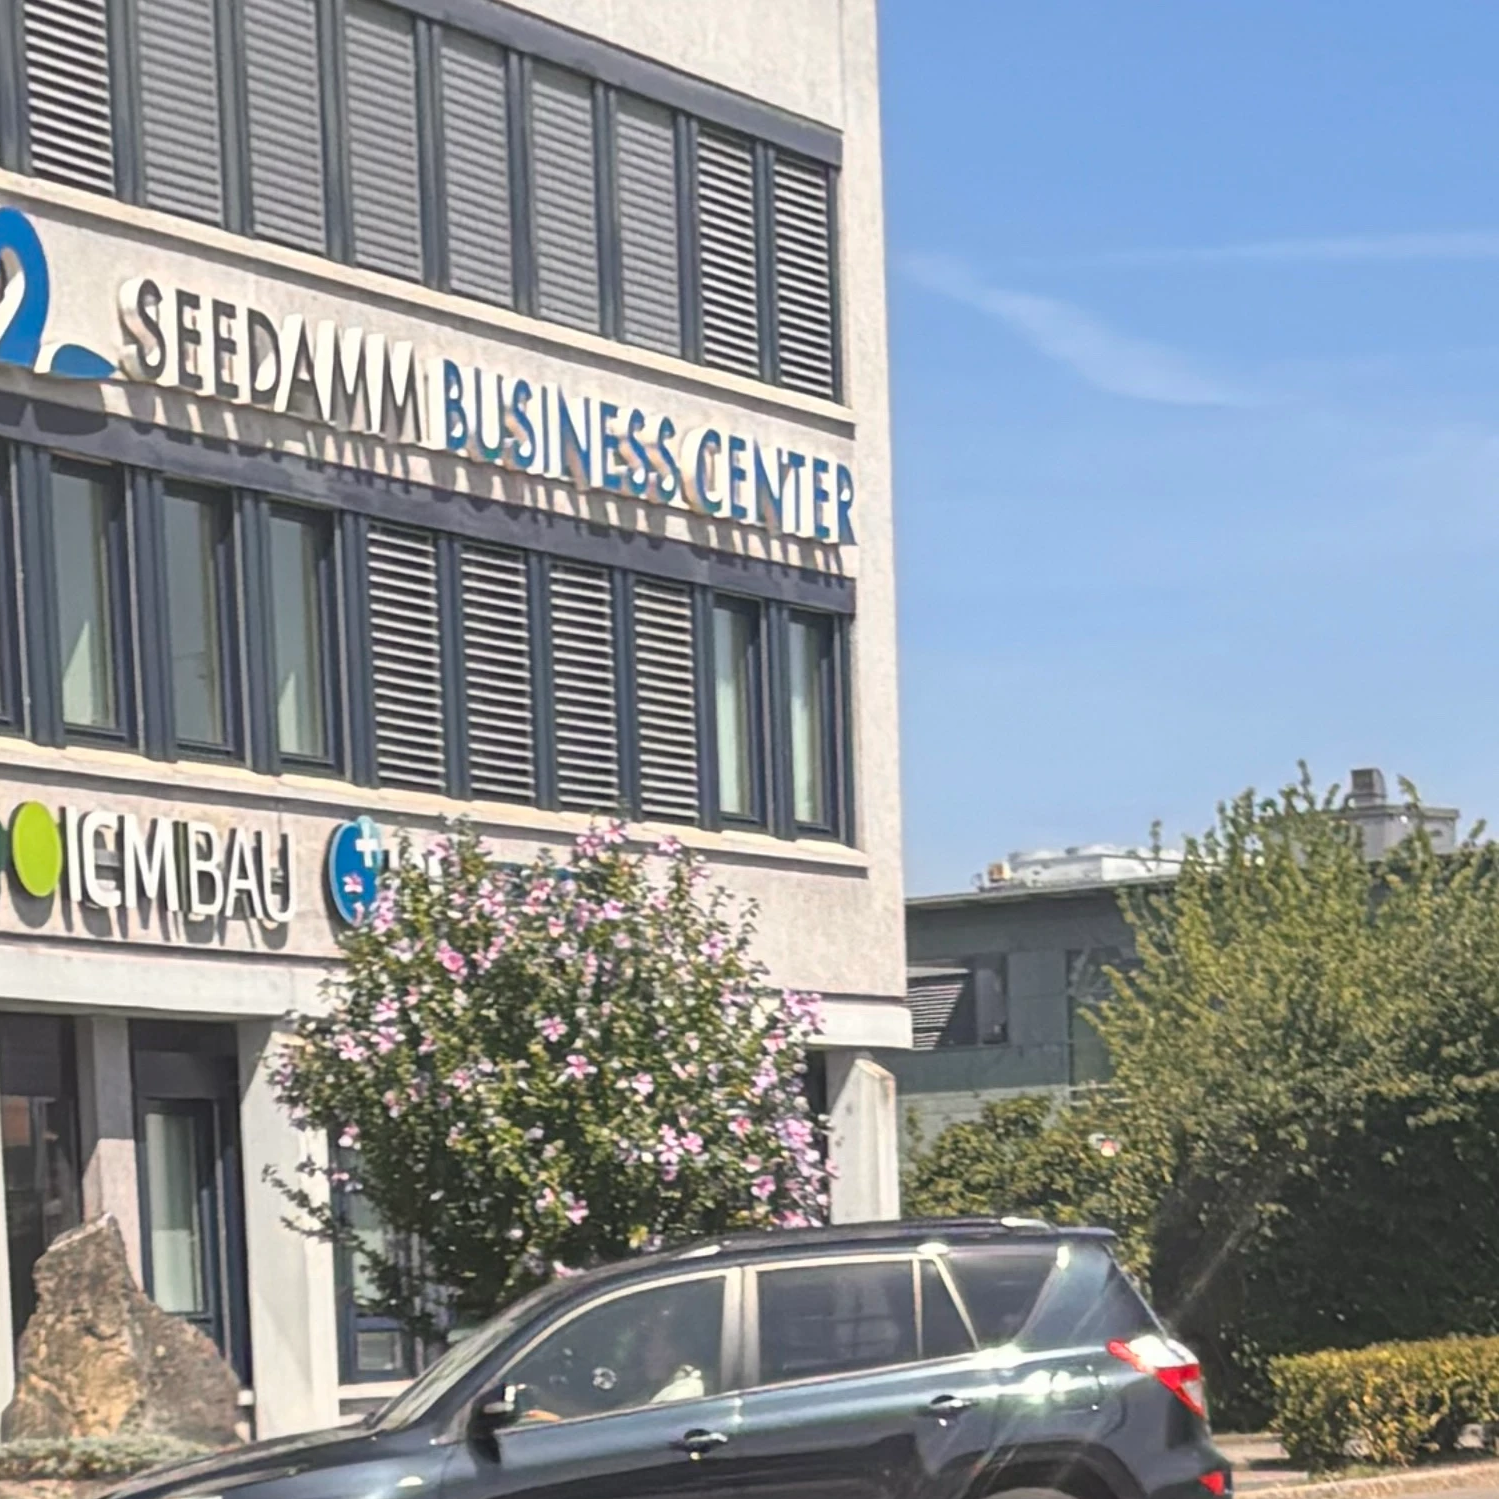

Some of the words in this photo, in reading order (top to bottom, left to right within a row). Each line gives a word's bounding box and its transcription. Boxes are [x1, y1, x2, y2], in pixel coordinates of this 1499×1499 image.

[118, 277, 423, 443] SEEDAMM
[429, 357, 681, 503] BUSINESS
[681, 426, 856, 547] CENTER
